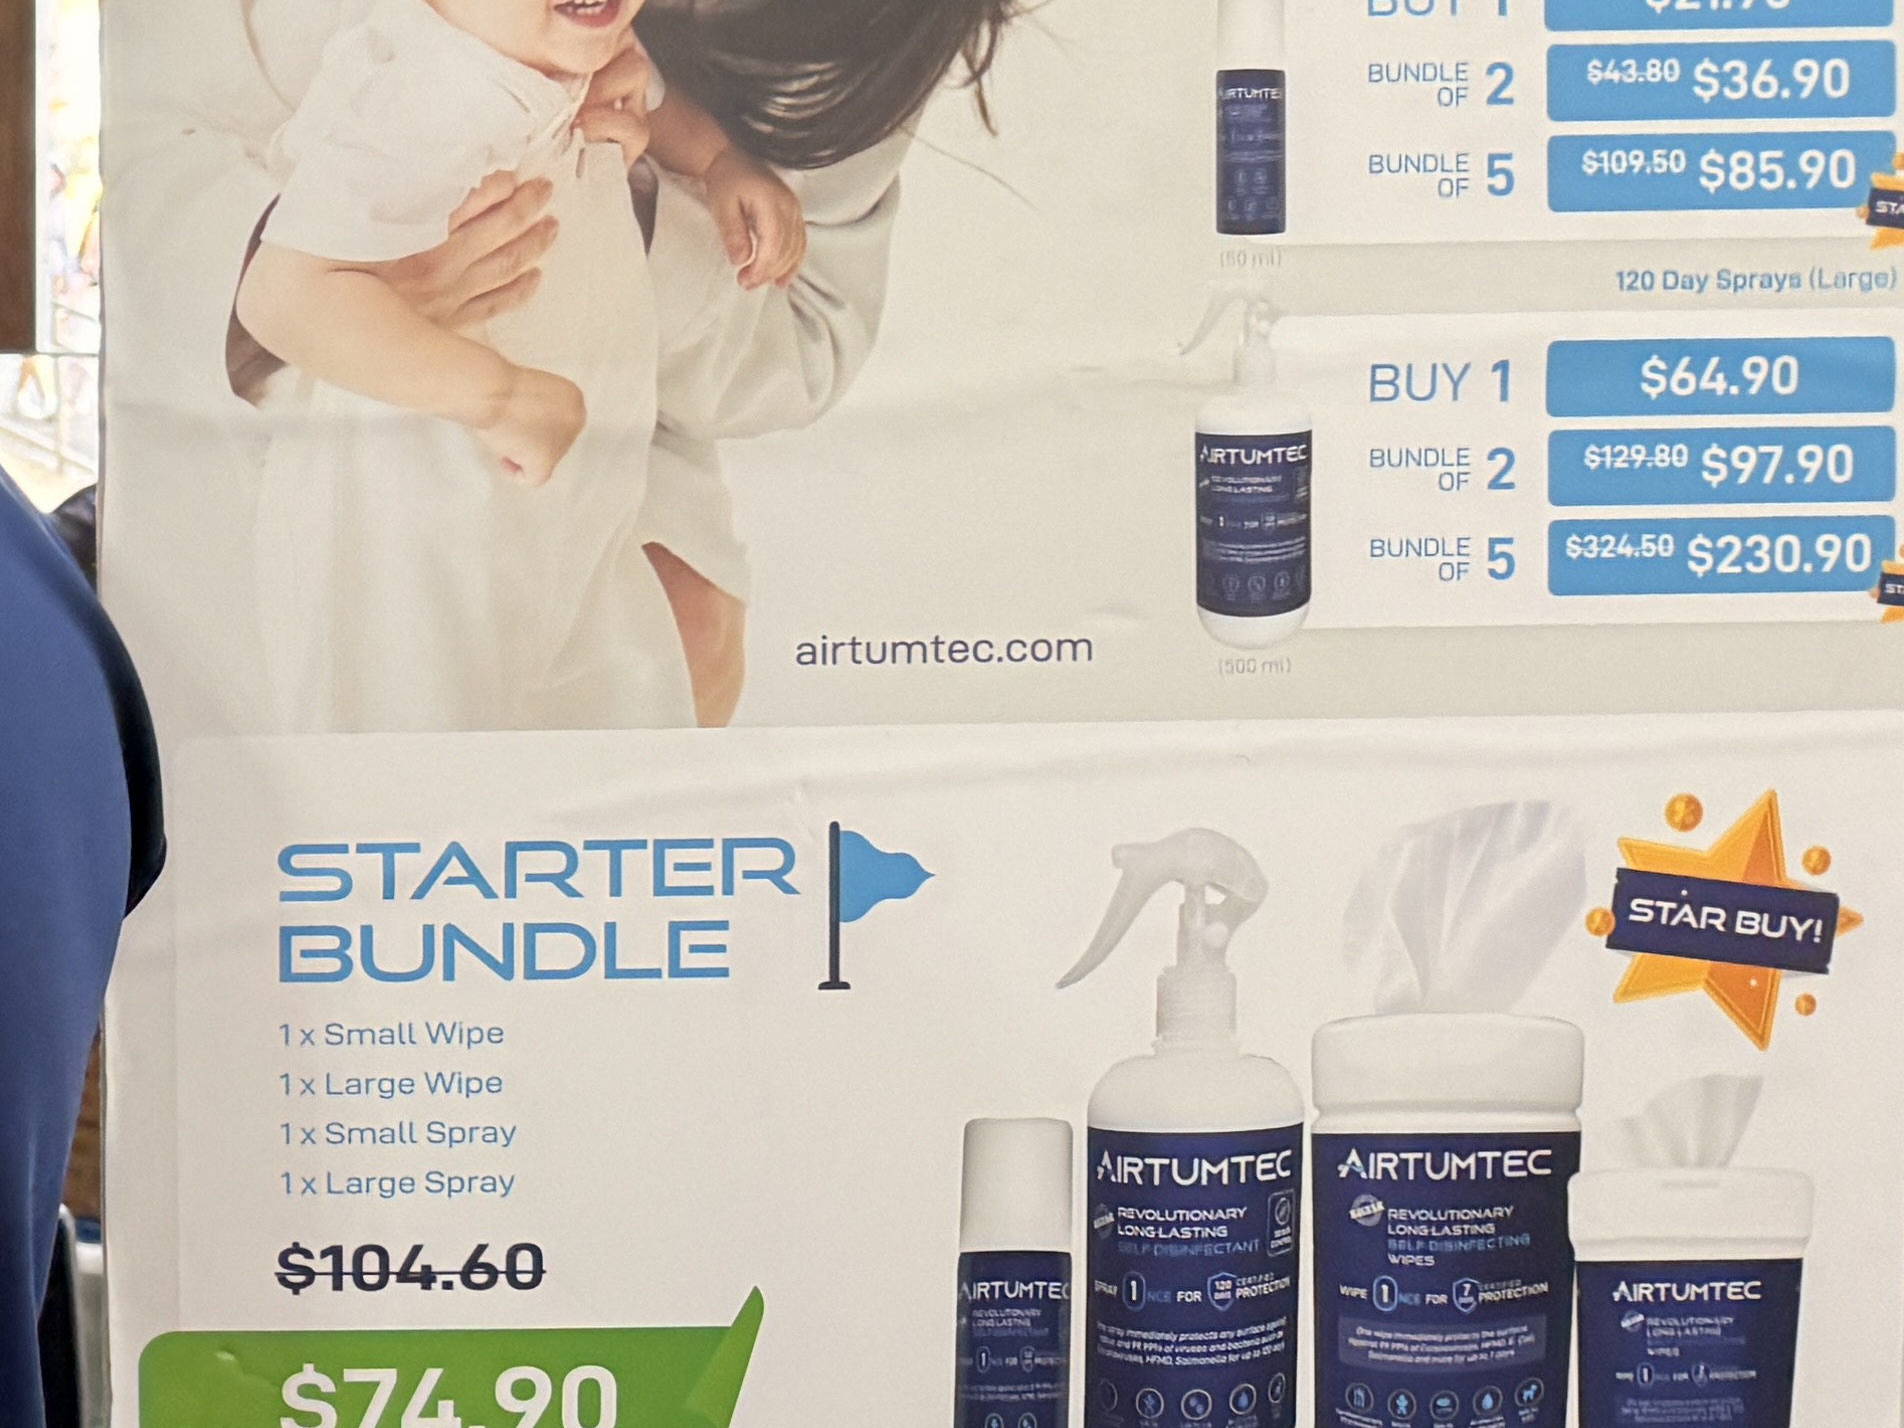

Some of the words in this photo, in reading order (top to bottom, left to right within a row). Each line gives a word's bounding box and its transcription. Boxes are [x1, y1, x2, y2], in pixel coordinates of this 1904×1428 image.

[1368, 62, 1469, 84] BUNDLE
[1485, 62, 1514, 106] 2
[1587, 58, 1680, 84] $43.80
[1693, 58, 1850, 101] $36.90
[1437, 86, 1468, 107] OF
[1369, 153, 1469, 174] BUNDLE
[1487, 153, 1514, 196] 5
[1582, 150, 1686, 175] $109.50
[1699, 150, 1855, 191] $85.90
[1437, 177, 1469, 199] OF
[1615, 270, 1655, 293] 120
[1662, 269, 1709, 295] Day
[1716, 269, 1801, 295] Sprays
[1809, 266, 1898, 293] (Large)
[1369, 364, 1470, 402] BUY
[1490, 359, 1511, 402] 1
[1641, 355, 1798, 399] $64.90
[1370, 448, 1470, 469] BUNDLE
[1487, 448, 1515, 491] 2
[1585, 444, 1688, 469] $129.80
[1701, 444, 1852, 486] $97.90
[1438, 472, 1470, 492] OF
[1370, 538, 1470, 559] BUNDLE
[1487, 538, 1515, 581] 5
[1567, 535, 1674, 561] $324.50
[1687, 534, 1871, 576] $230.90
[1438, 562, 1470, 582] OF
[796, 634, 1092, 666] airtumtec.com
[277, 837, 802, 904] STARTER
[1629, 898, 1726, 932] STAR
[1735, 910, 1823, 943] BUY!
[278, 919, 730, 984] BUNDLE
[279, 1024, 291, 1047] 1
[299, 1029, 315, 1047] x
[324, 1021, 417, 1048] Small
[424, 1021, 505, 1051] Wipe
[279, 1074, 291, 1096] 1
[300, 1080, 316, 1097] x
[325, 1070, 415, 1101] Large
[424, 1070, 503, 1101] Wipe
[280, 1124, 291, 1146] 1
[301, 1129, 316, 1146] x
[325, 1121, 418, 1147] Small
[426, 1121, 517, 1150] Spray
[1097, 1149, 1292, 1186] AIRTUMTEC
[1338, 1148, 1551, 1180] AIRTUMTEC
[280, 1173, 292, 1195] 1
[301, 1179, 317, 1196] x
[327, 1171, 417, 1200] Large
[424, 1171, 516, 1200] Spray
[1118, 1206, 1247, 1221] REVOLUTIONARY
[1388, 1206, 1513, 1220] REVOLUTIONARY
[275, 1241, 546, 1295] $104.60
[1388, 1254, 1435, 1267] WIPES
[1177, 1290, 1202, 1302] FOR
[1340, 1284, 1367, 1300] WIPE
[1426, 1294, 1447, 1305] FOR
[1479, 1282, 1548, 1303] PROTECTION
[1612, 1281, 1761, 1302] AIRTUMTEC
